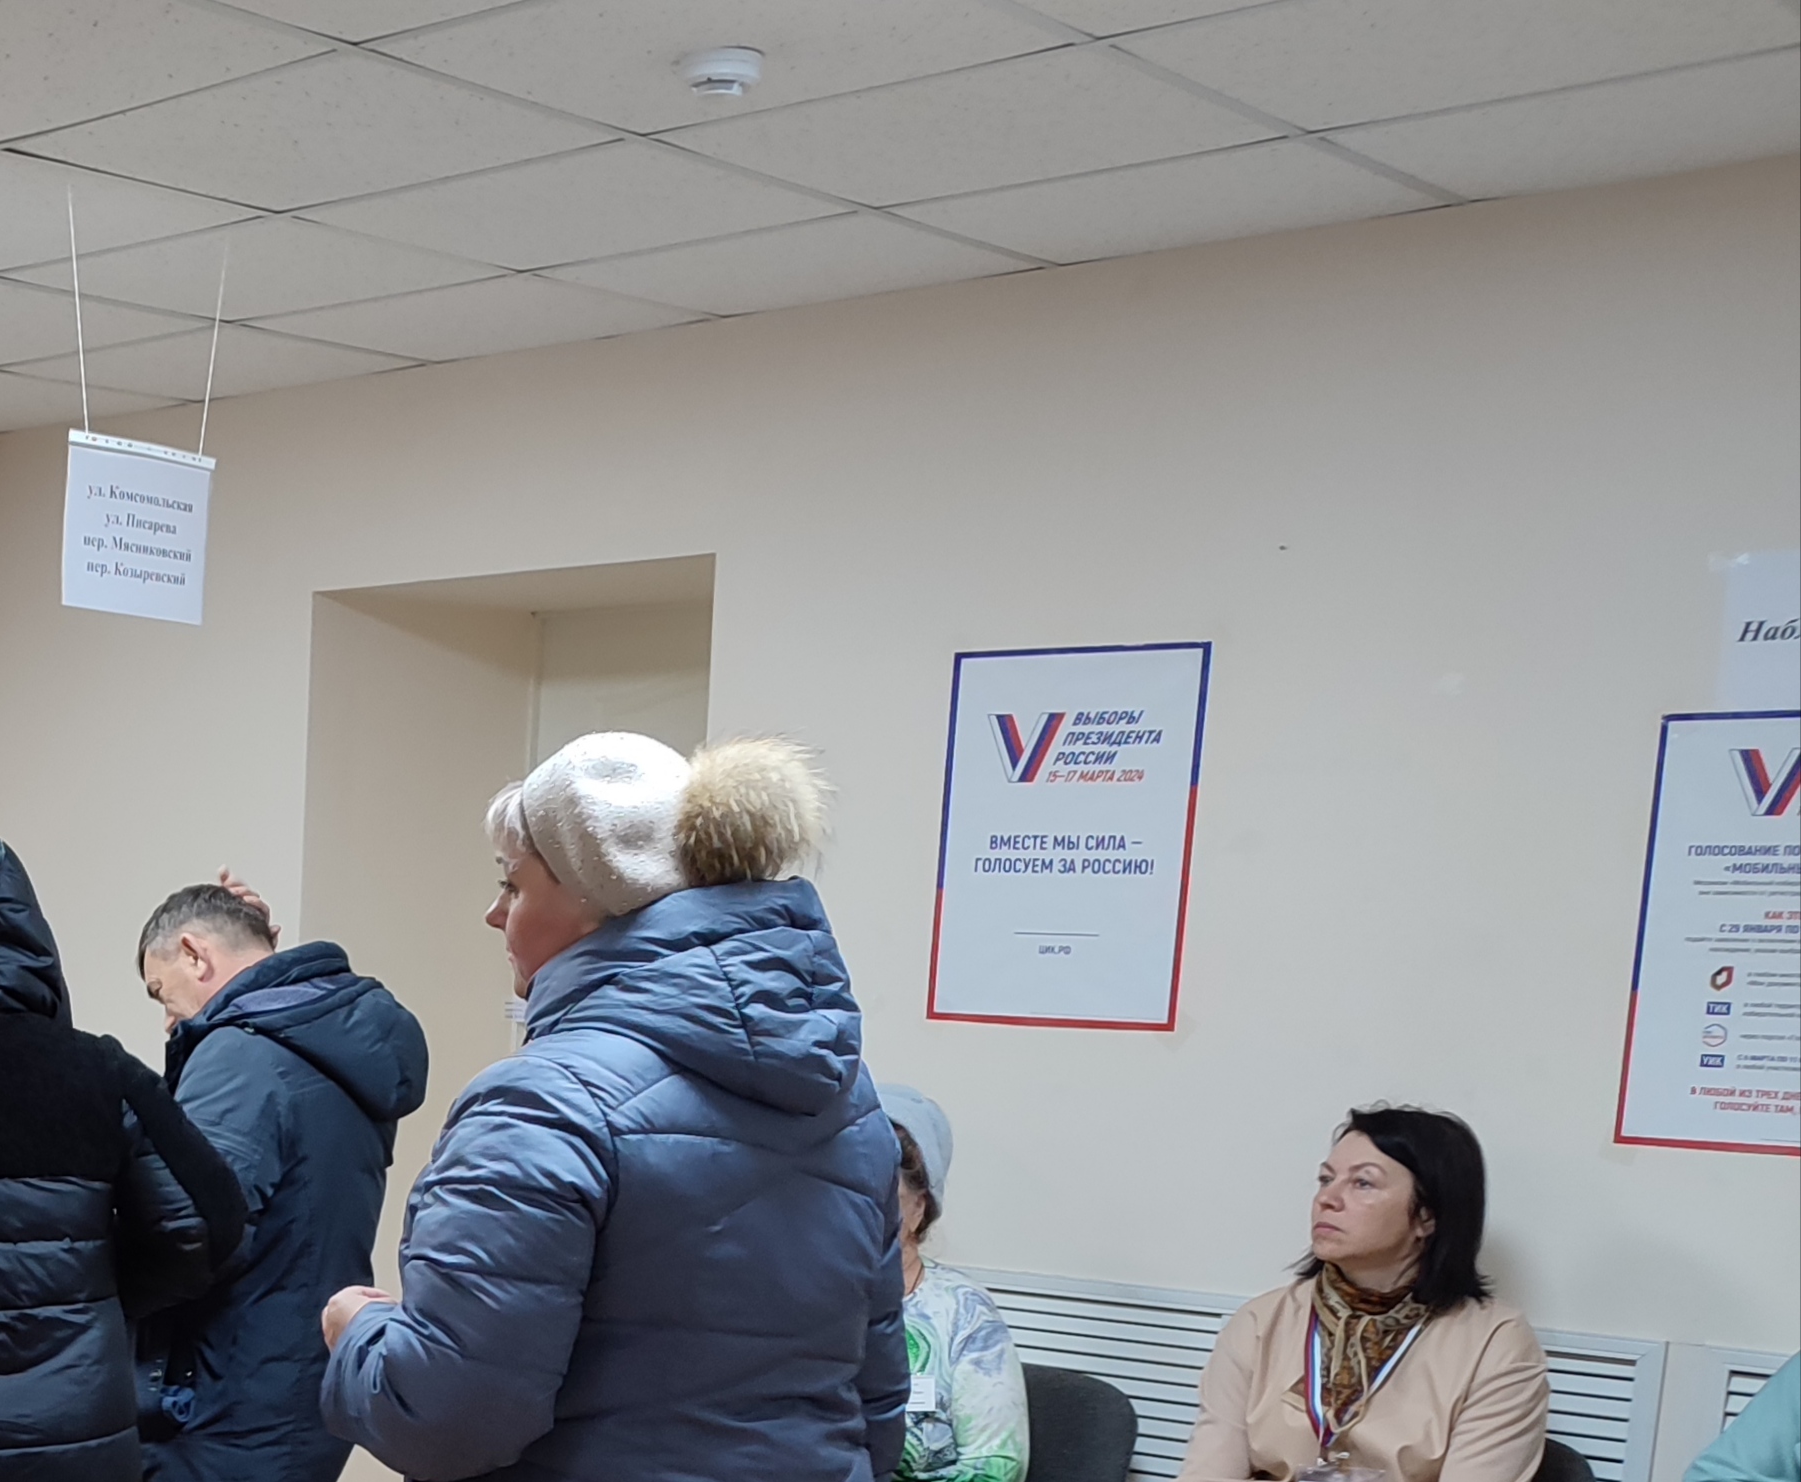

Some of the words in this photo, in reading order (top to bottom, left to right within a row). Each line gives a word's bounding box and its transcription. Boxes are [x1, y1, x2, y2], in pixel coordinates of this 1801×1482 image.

[87, 484, 105, 498] ул.
[109, 485, 193, 513] Комсомольская
[104, 513, 122, 527] ул.
[126, 513, 177, 535] Писарева
[83, 535, 107, 551] пер.
[112, 536, 192, 562] Мясниковский
[87, 561, 110, 577] пер.
[114, 562, 185, 585] Козыревский
[1073, 709, 1144, 725] ВЫБОРЫ
[1063, 731, 1161, 747] ПРЕЗИДЕНТА
[1053, 751, 1117, 766] РОССИИ
[1078, 770, 1115, 783] МАРТА
[1117, 769, 1145, 782] 2024
[989, 834, 1048, 851] ВМЕСТЕ
[1053, 835, 1080, 851] МЫ
[1085, 835, 1126, 852] СИЛА
[1688, 845, 1780, 856] ГОЛОСОВАНИЕ
[973, 857, 1053, 874] ГОЛОСУЕМ
[1057, 858, 1077, 874] ЗА
[1081, 858, 1154, 875] РОССИЮ!
[1720, 924, 1726, 932] С
[1742, 924, 1782, 933] ЯНВАРЯ
[1038, 944, 1071, 955] ЦИК.РФ
[1709, 1004, 1728, 1013] ТИК
[1702, 1056, 1723, 1065] УИК
[1739, 1089, 1753, 1097] ИЗ
[1781, 1092, 1800, 1100] ДНЕ
